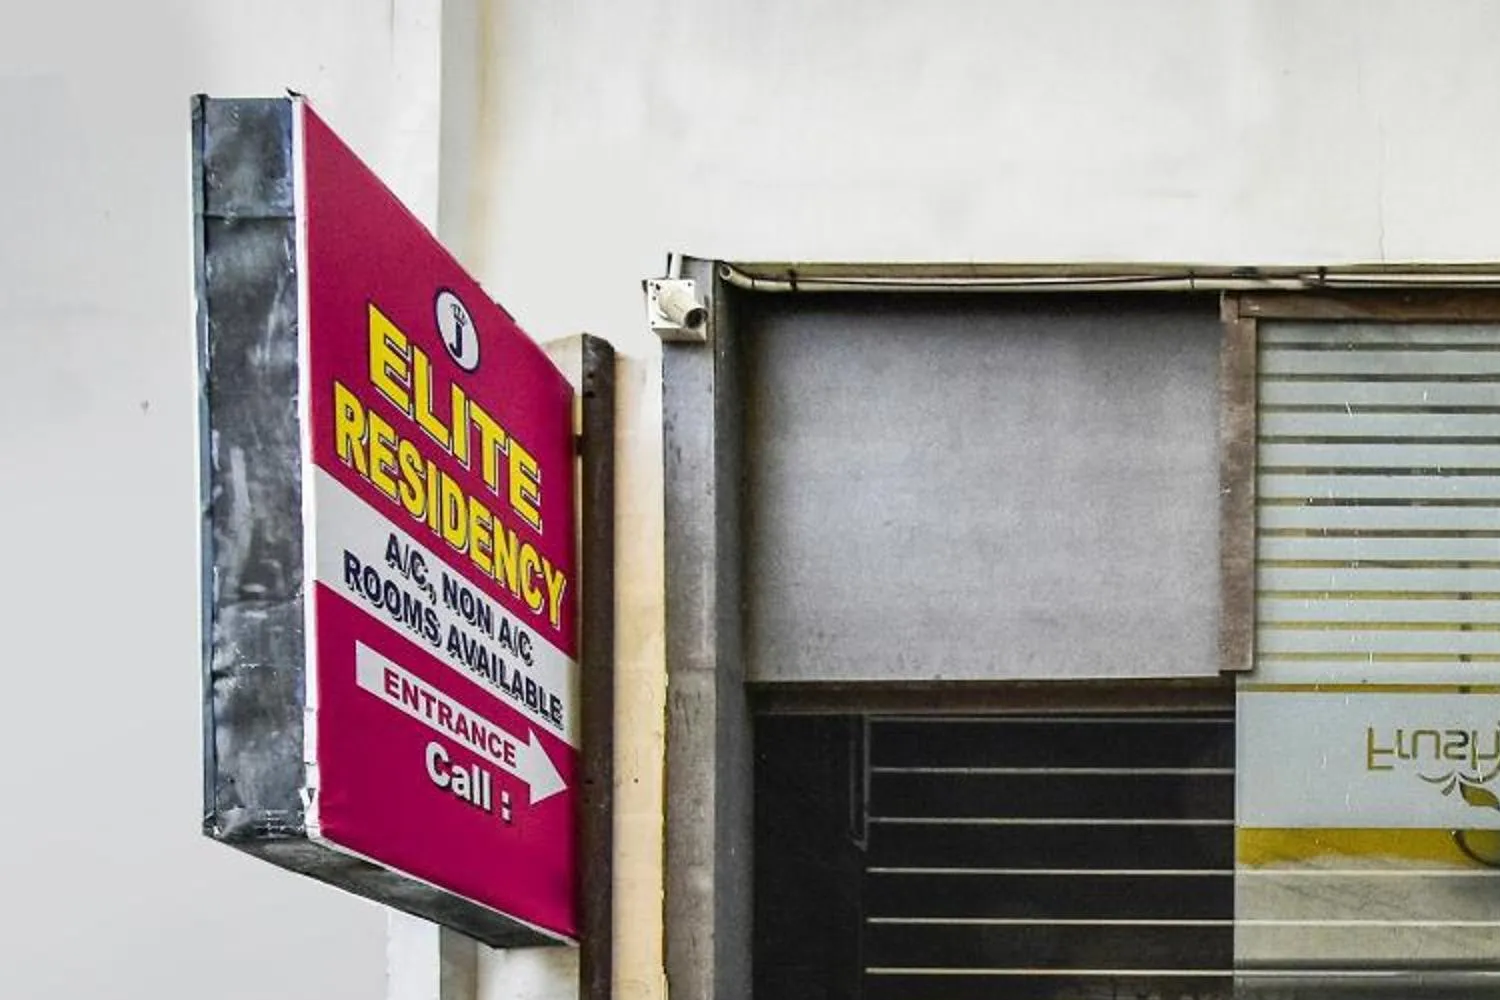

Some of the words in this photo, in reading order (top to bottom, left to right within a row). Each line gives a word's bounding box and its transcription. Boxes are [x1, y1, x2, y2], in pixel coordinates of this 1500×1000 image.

[334, 380, 567, 631] RESIDENCY
[368, 302, 543, 534] ELITE
[344, 549, 442, 648] ROOMS
[447, 624, 564, 730] AVAILABLE
[442, 572, 494, 639] NON
[384, 667, 516, 768] ENTRANCE
